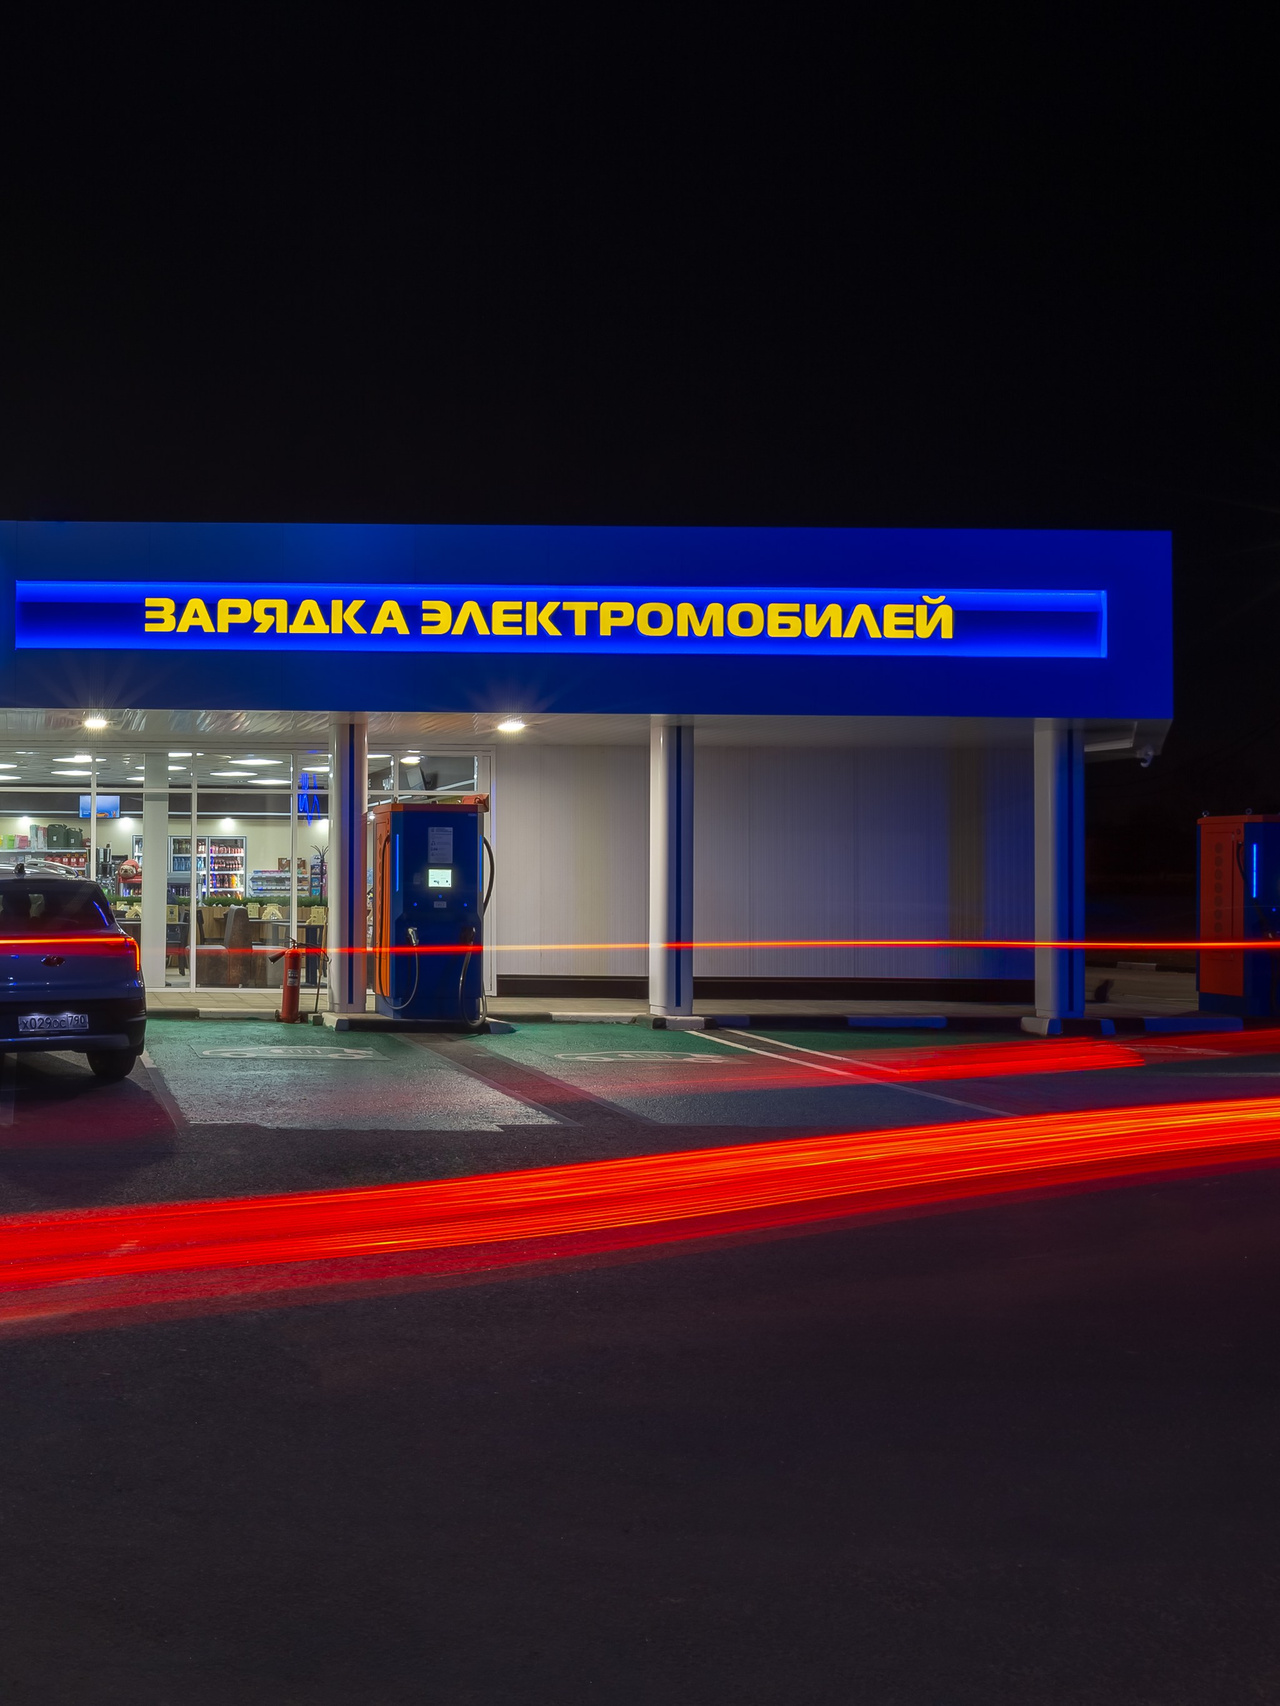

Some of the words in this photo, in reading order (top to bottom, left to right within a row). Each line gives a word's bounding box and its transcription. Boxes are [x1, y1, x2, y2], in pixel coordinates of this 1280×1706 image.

[144, 597, 410, 635] ЗАРЯДКА
[421, 595, 953, 639] ЭЛЕКТРОМОБИЛЕЙ
[68, 1015, 85, 1026] 790
